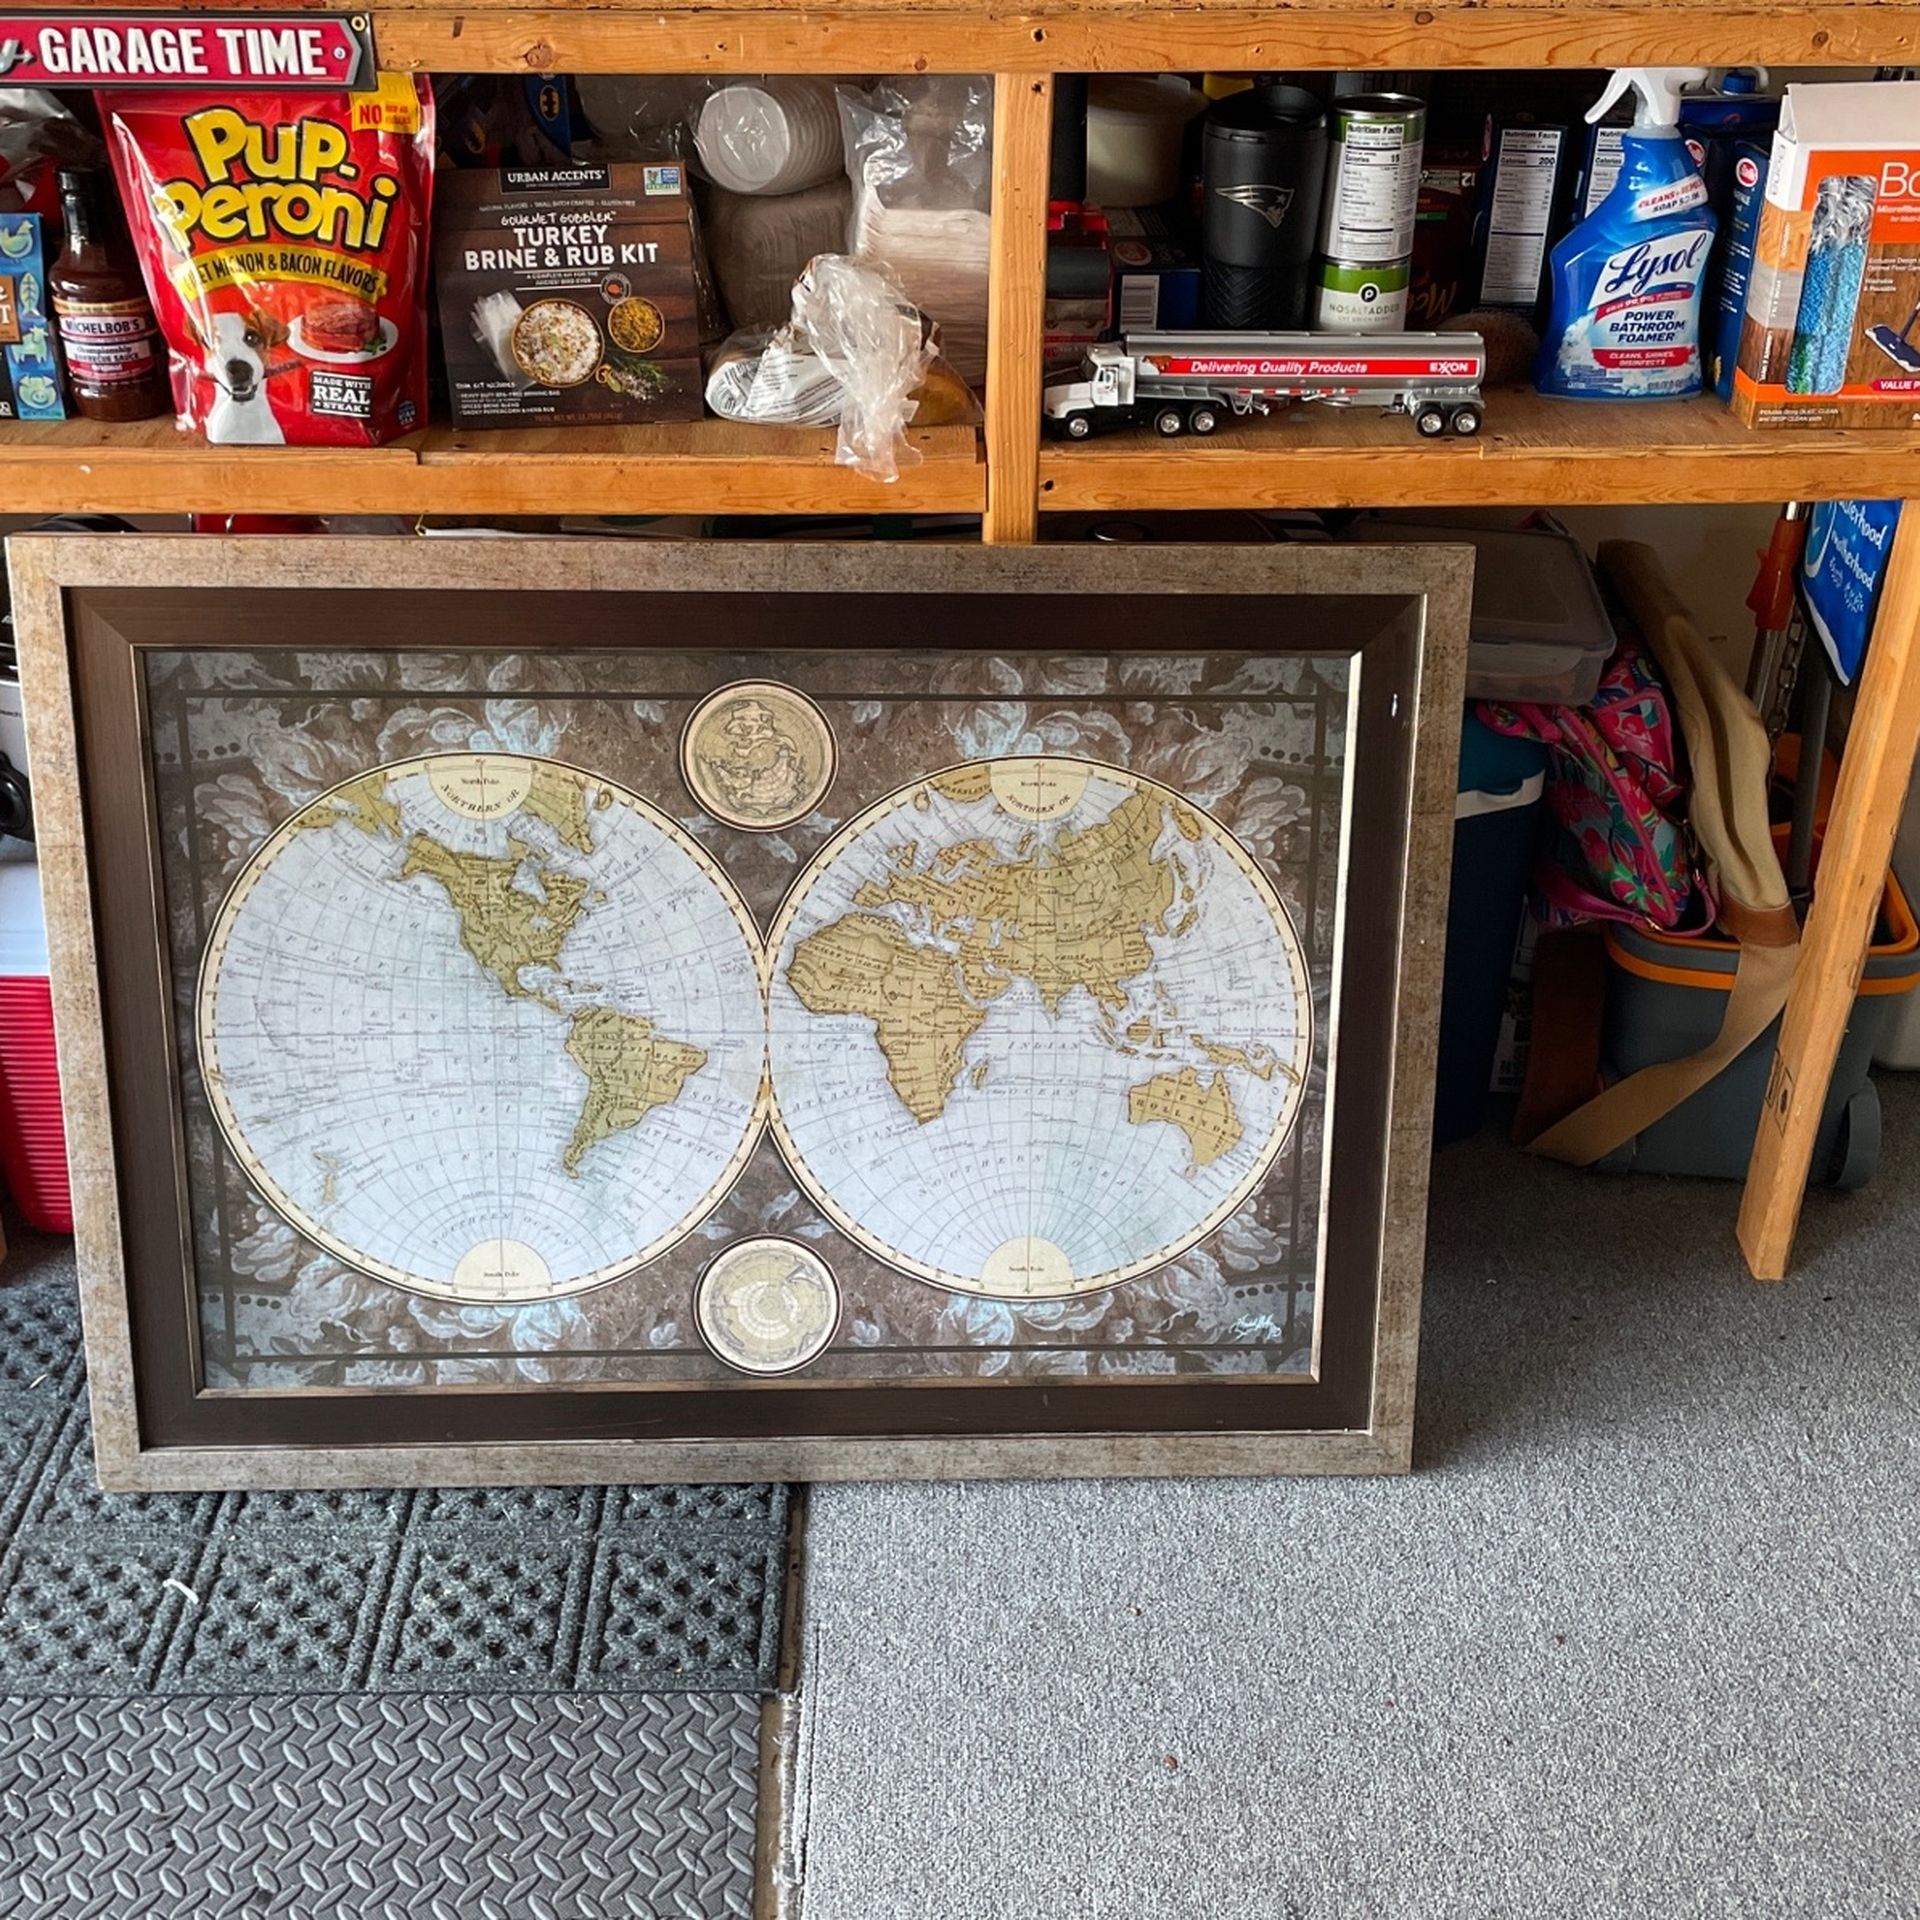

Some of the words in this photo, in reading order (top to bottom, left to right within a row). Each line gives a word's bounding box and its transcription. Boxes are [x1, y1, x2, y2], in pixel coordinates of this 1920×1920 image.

[38, 27, 209, 74] GARAGE
[216, 28, 327, 76] TIME
[1538, 157, 1556, 166] 200
[507, 171, 549, 183] URBAN
[551, 170, 602, 182] ACCENTS
[501, 212, 557, 226] GOURMET
[513, 224, 608, 247] TURKEY
[465, 248, 538, 271] BRINE
[544, 247, 561, 267] &
[566, 246, 615, 266] RUB
[621, 243, 658, 264] KIT
[1604, 232, 1707, 295] Lysol
[269, 255, 277, 271] &
[280, 253, 322, 274] BACON
[323, 259, 380, 294] FLAVORS
[1624, 310, 1675, 321] POWER
[1609, 320, 1685, 333] BATHROOM
[1617, 332, 1676, 343] FOAMER
[1191, 360, 1257, 375] Delivering
[1259, 361, 1304, 376] Quality
[1308, 361, 1368, 374] Products
[1429, 361, 1469, 375] EXXON
[313, 375, 343, 387] MADE
[1880, 380, 1911, 390] VALUE
[313, 385, 371, 405] REAL
[322, 401, 362, 412] STEAK
